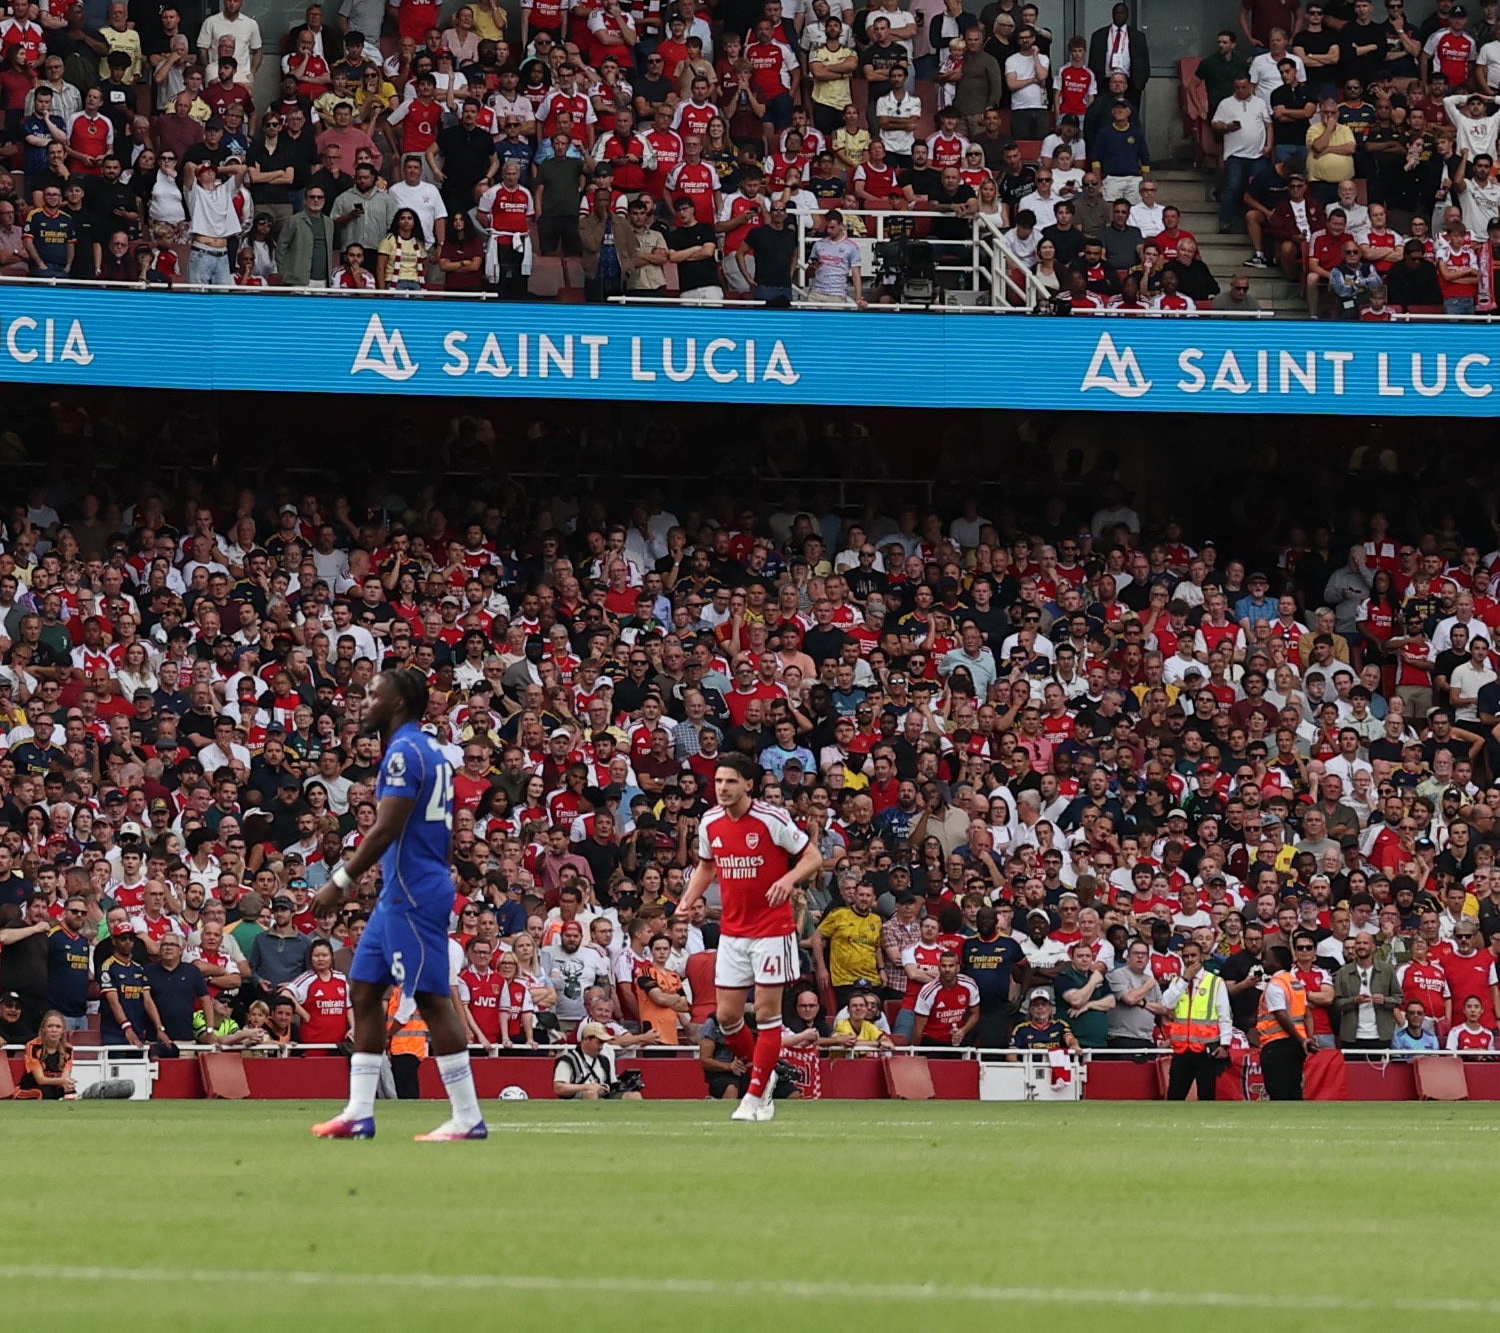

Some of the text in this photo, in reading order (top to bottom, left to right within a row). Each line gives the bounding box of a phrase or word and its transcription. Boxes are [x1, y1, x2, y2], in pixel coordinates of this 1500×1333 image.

[442, 329, 802, 387] SAINT LUCIA
[1176, 347, 1354, 395] SAINT
[715, 853, 765, 868] Emirates
[763, 955, 782, 976] 41
[474, 995, 497, 1008] JVC
